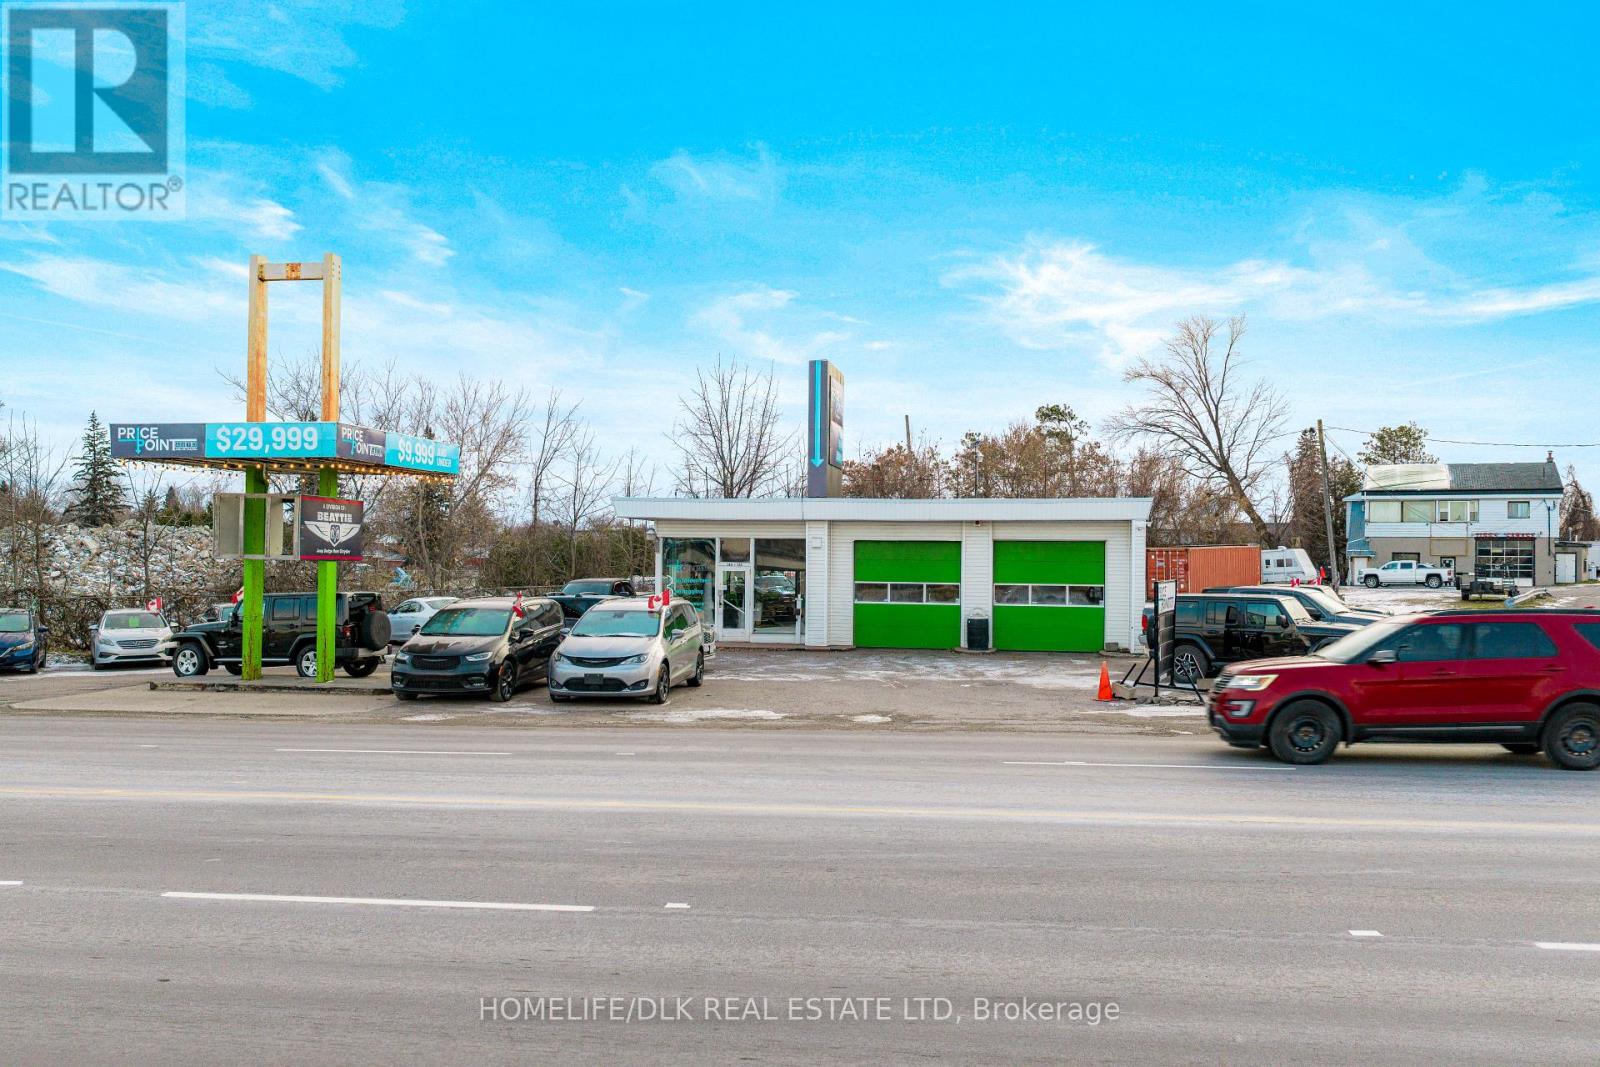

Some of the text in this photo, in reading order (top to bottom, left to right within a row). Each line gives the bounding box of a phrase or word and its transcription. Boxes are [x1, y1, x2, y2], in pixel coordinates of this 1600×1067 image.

[117, 427, 159, 440] PRICE
[216, 425, 318, 454] $29,999
[341, 427, 364, 442] PRICE
[136, 438, 190, 454] POINT
[398, 438, 435, 465] $9,999
[317, 511, 353, 523] BEATTIE
